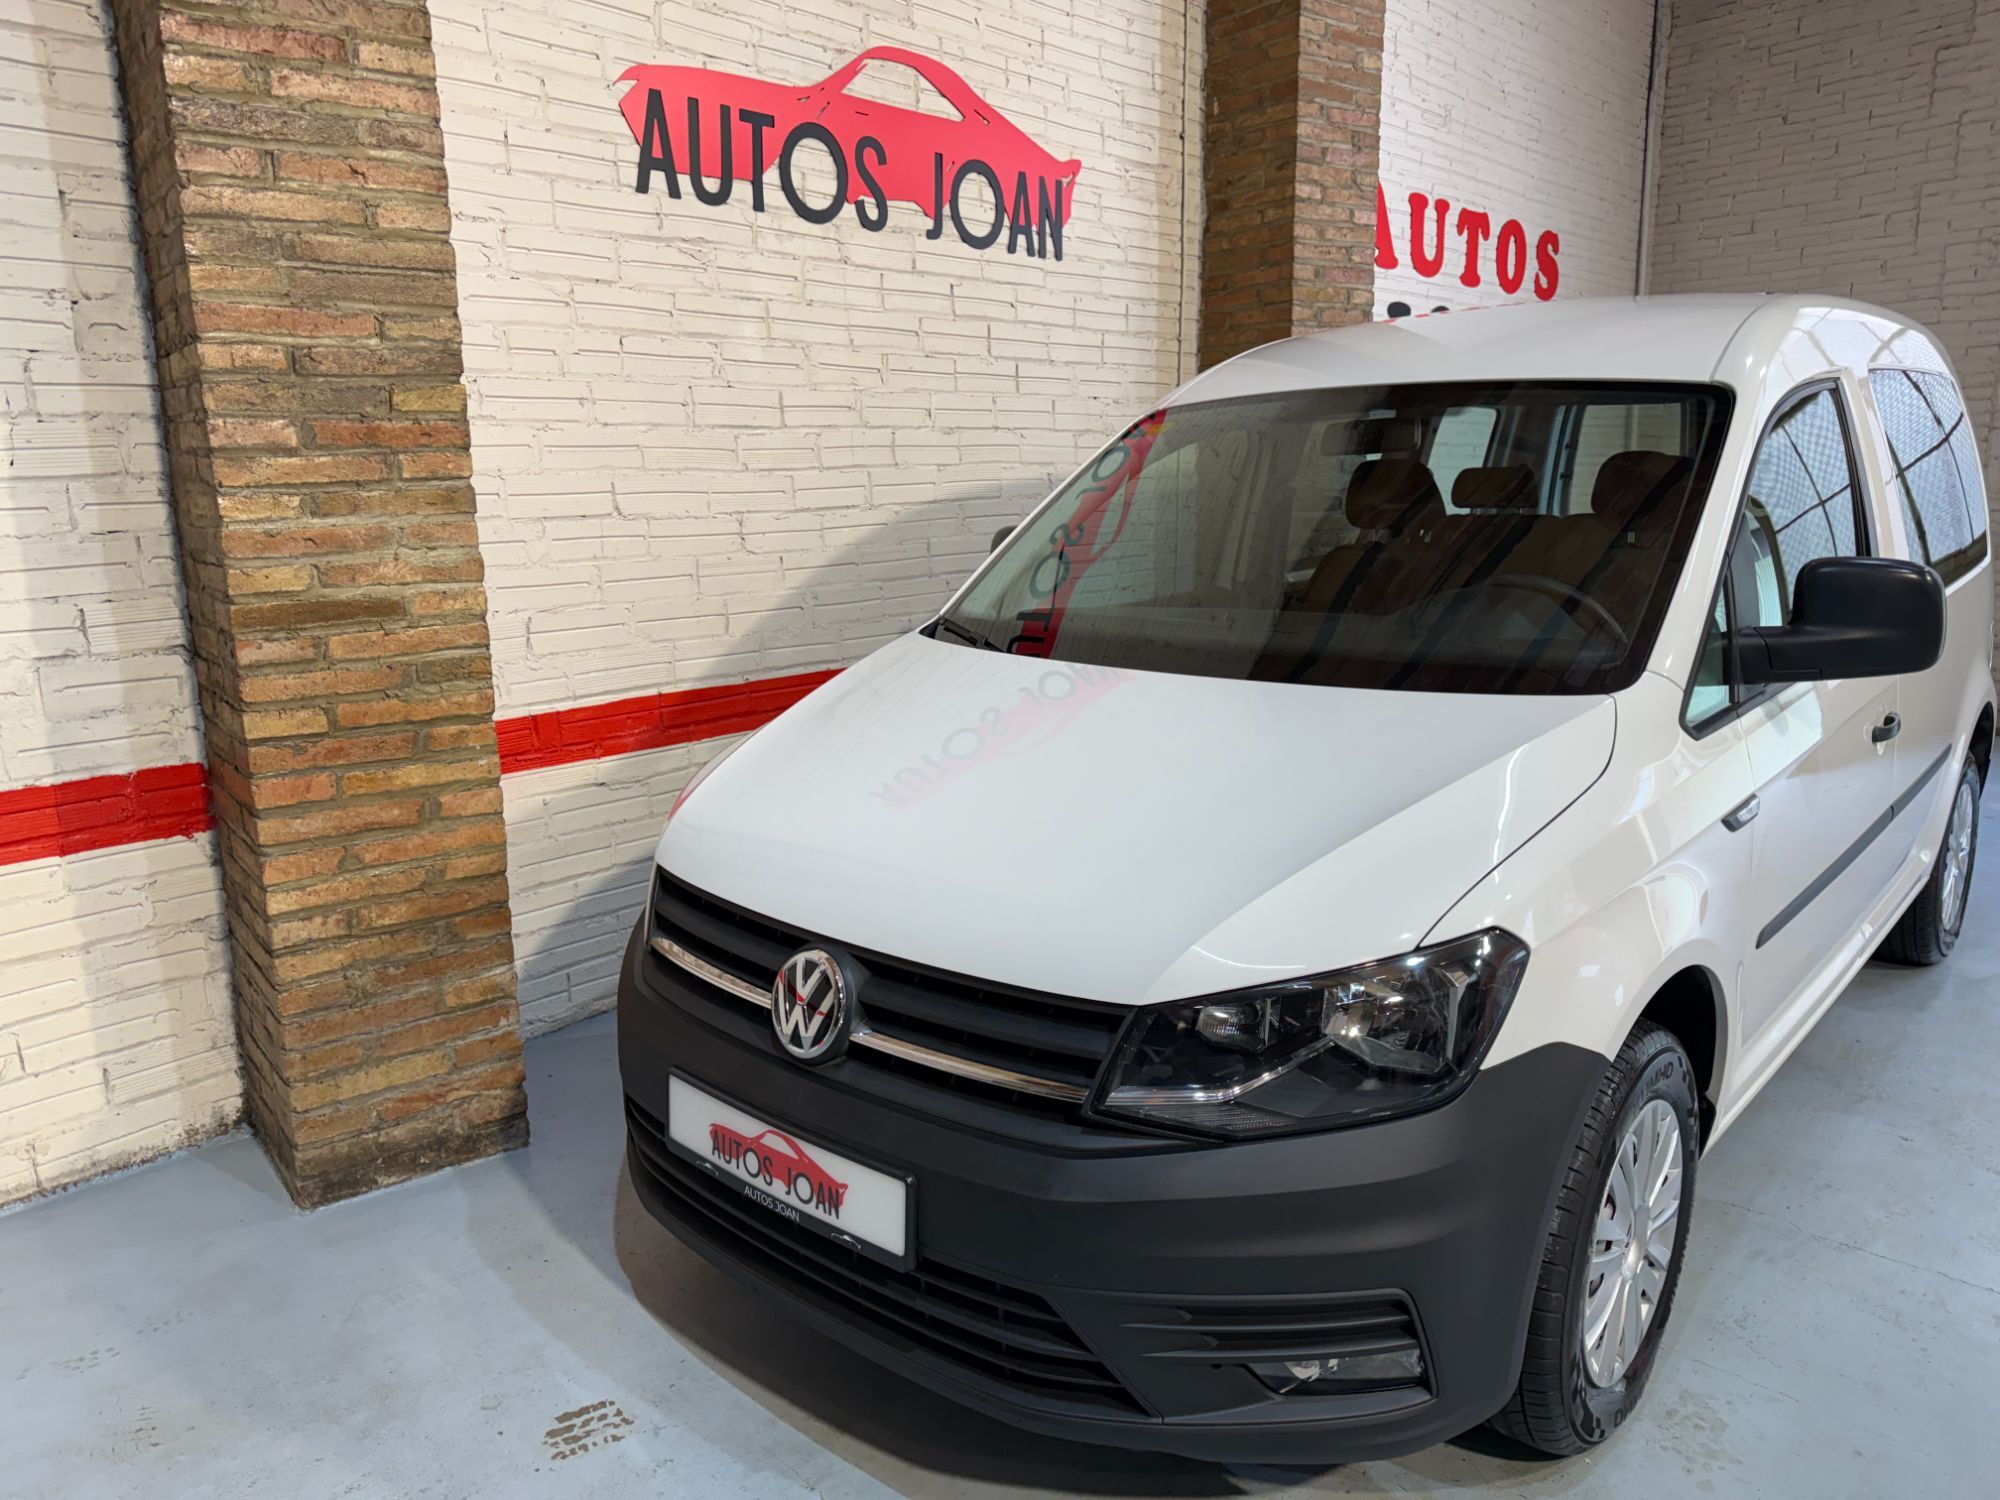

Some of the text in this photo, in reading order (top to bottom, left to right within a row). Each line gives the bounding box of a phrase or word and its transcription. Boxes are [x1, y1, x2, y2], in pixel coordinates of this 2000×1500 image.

[636, 88, 1063, 261] AUTOS JOAN
[711, 1129, 840, 1220] AUTOS JOAN
[744, 1186, 800, 1222] AUTOS JOAN
